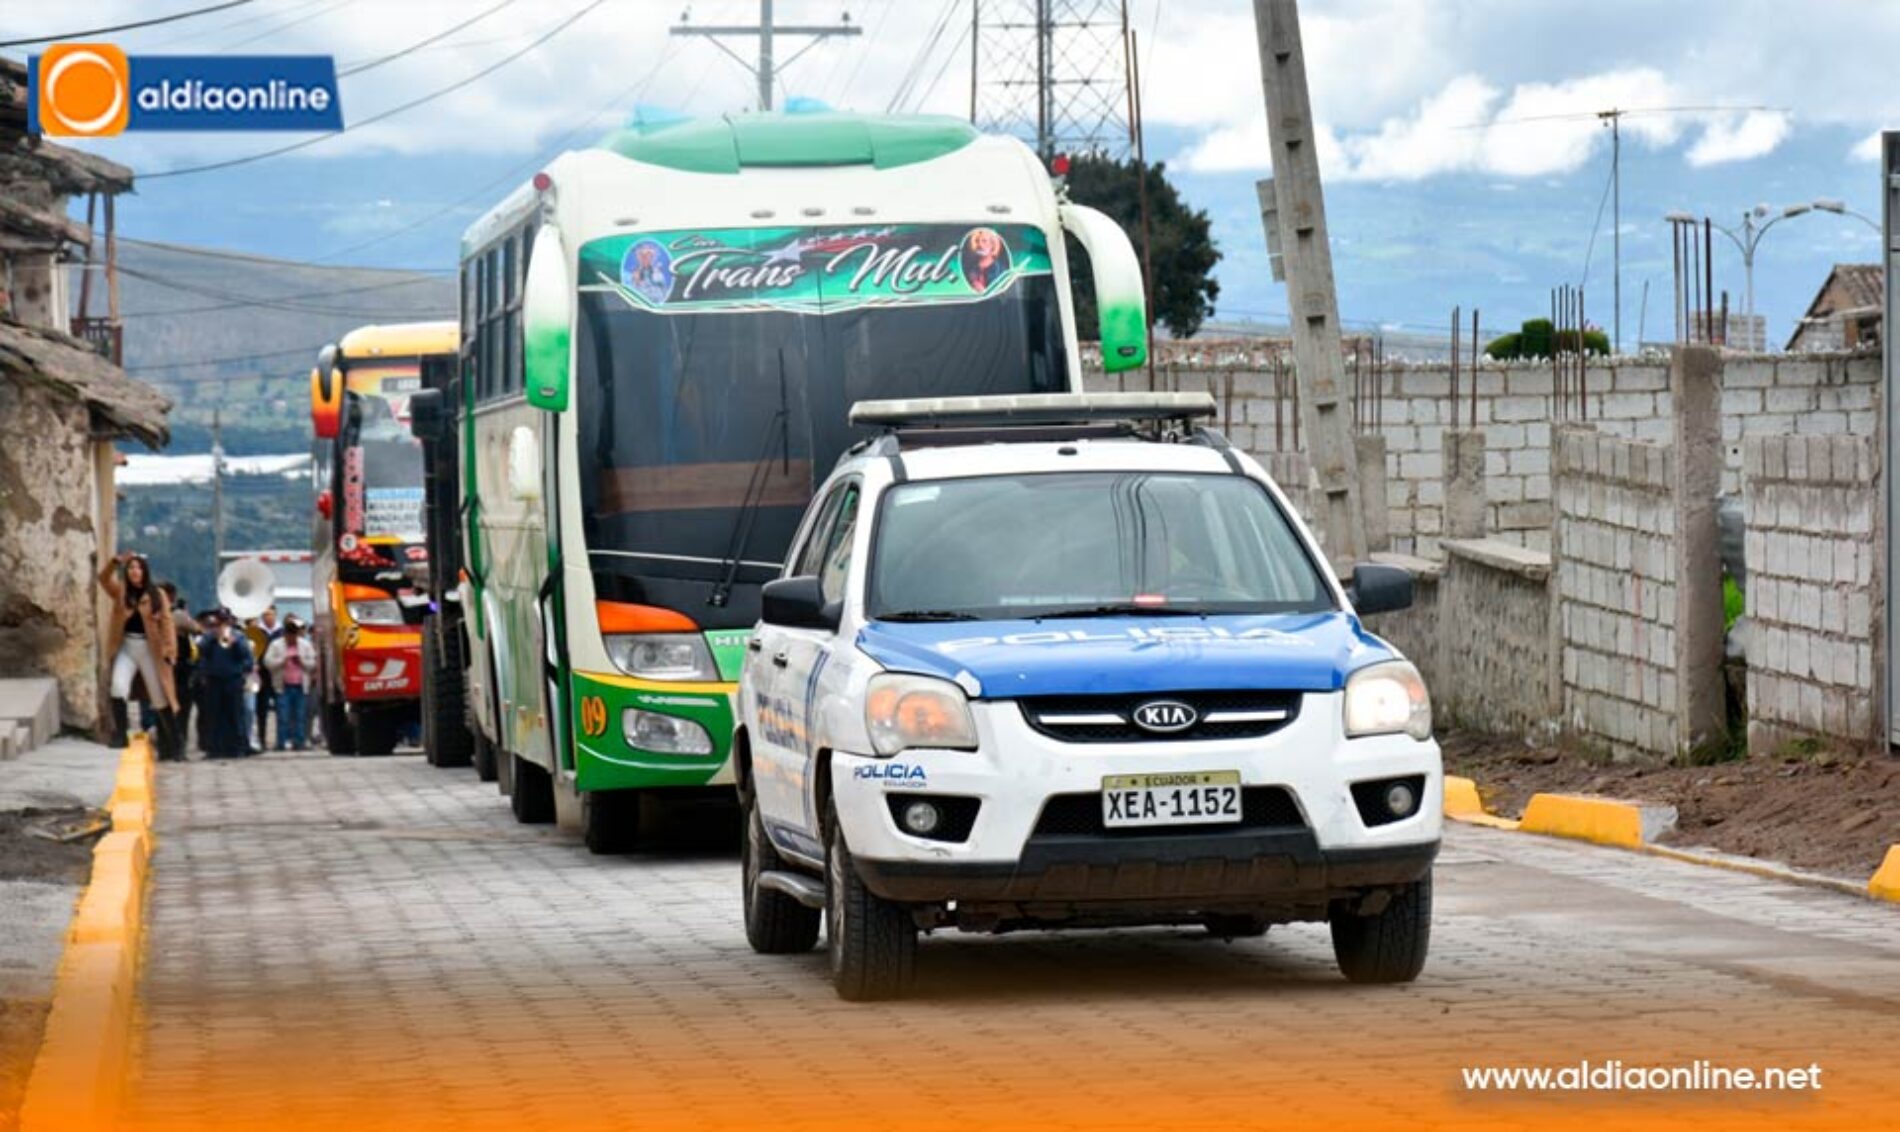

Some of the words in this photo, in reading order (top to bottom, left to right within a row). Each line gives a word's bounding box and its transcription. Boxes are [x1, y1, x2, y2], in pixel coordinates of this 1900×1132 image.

[668, 247, 805, 299] Trans
[825, 242, 958, 293] Mul.
[936, 625, 1317, 652] POLICIA
[581, 696, 606, 736] 09
[1145, 707, 1186, 724] KIA
[853, 765, 926, 779] POLICIA
[1145, 775, 1197, 787] ECUADOR
[1107, 787, 1238, 820] XEA-1152
